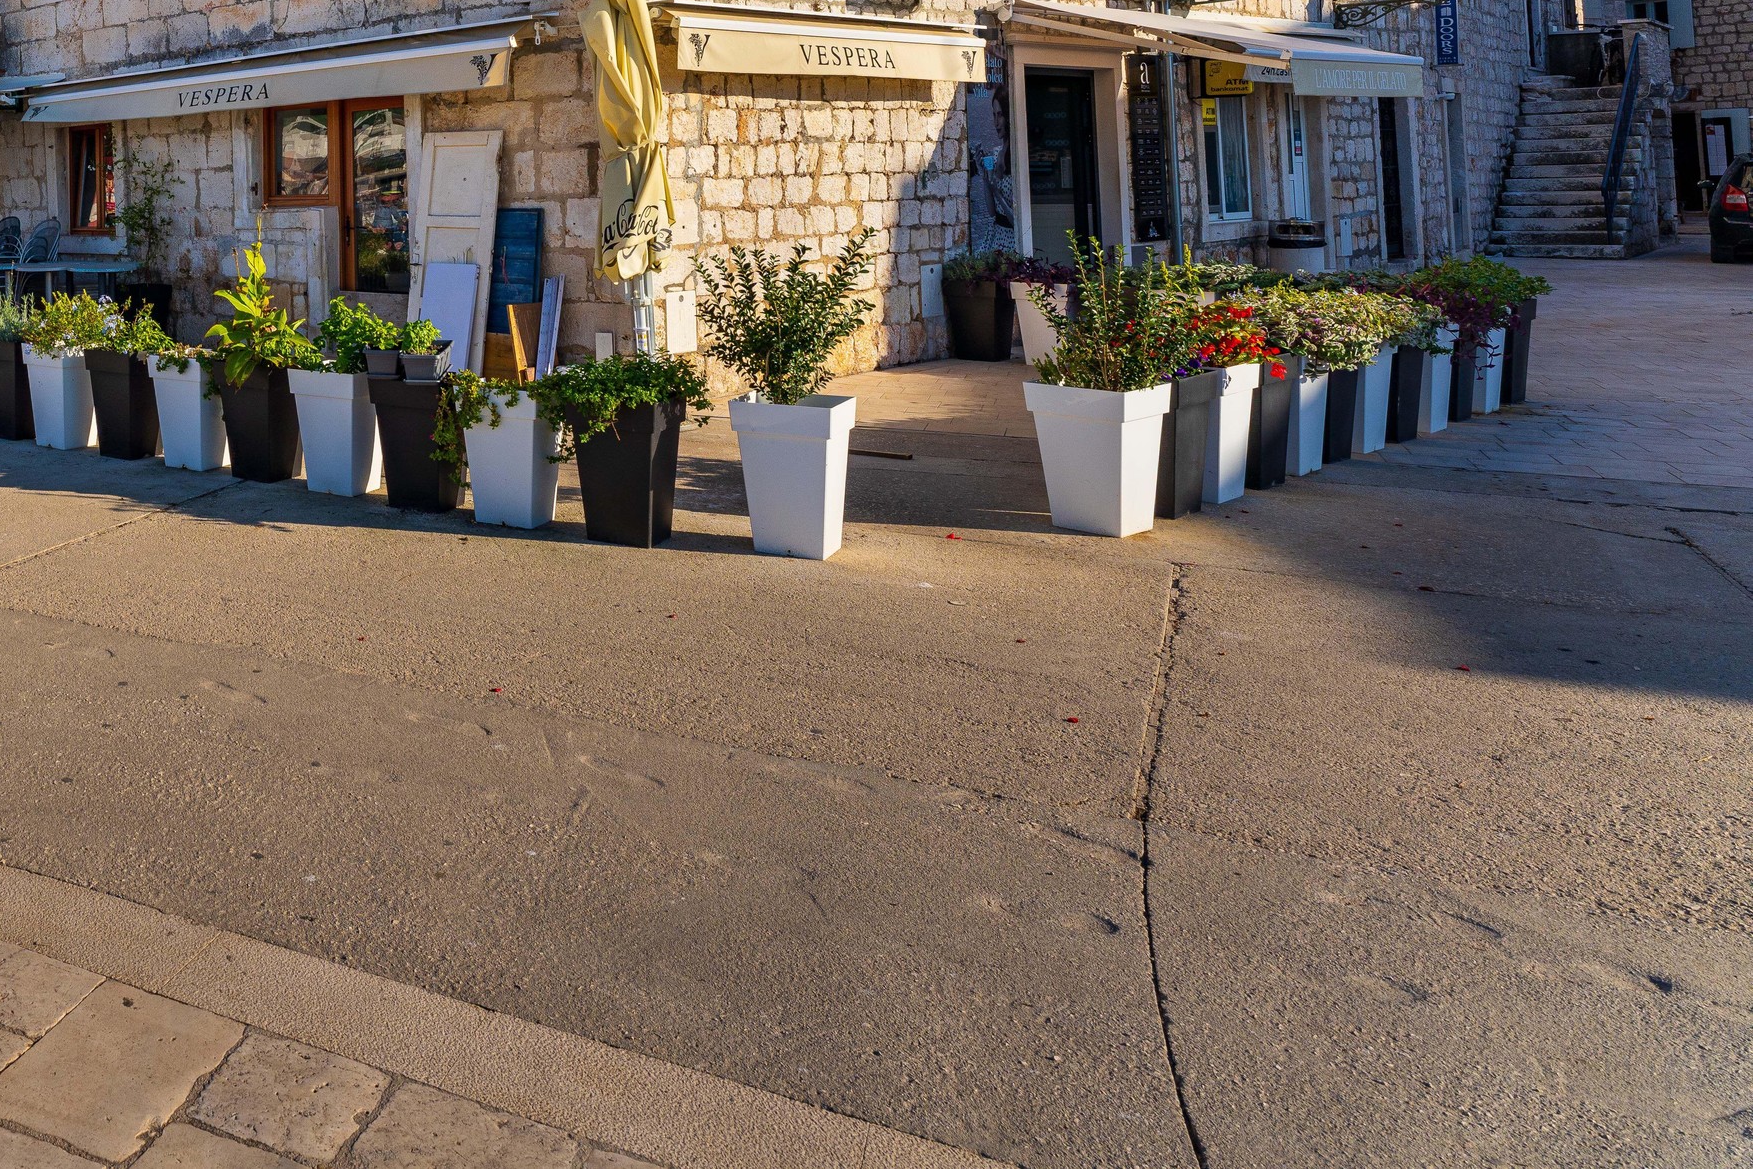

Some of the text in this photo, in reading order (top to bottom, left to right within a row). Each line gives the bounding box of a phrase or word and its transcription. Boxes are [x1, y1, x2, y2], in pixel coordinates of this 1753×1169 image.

[1440, 17, 1454, 55] DOORS
[799, 44, 896, 70] VESPERA
[987, 69, 1003, 83] olce
[1140, 62, 1150, 84] a
[1226, 78, 1249, 86] ATM
[1353, 70, 1367, 90] PER
[1377, 71, 1406, 90] GELATO
[178, 82, 269, 108] VESPERA
[973, 83, 989, 98] vita
